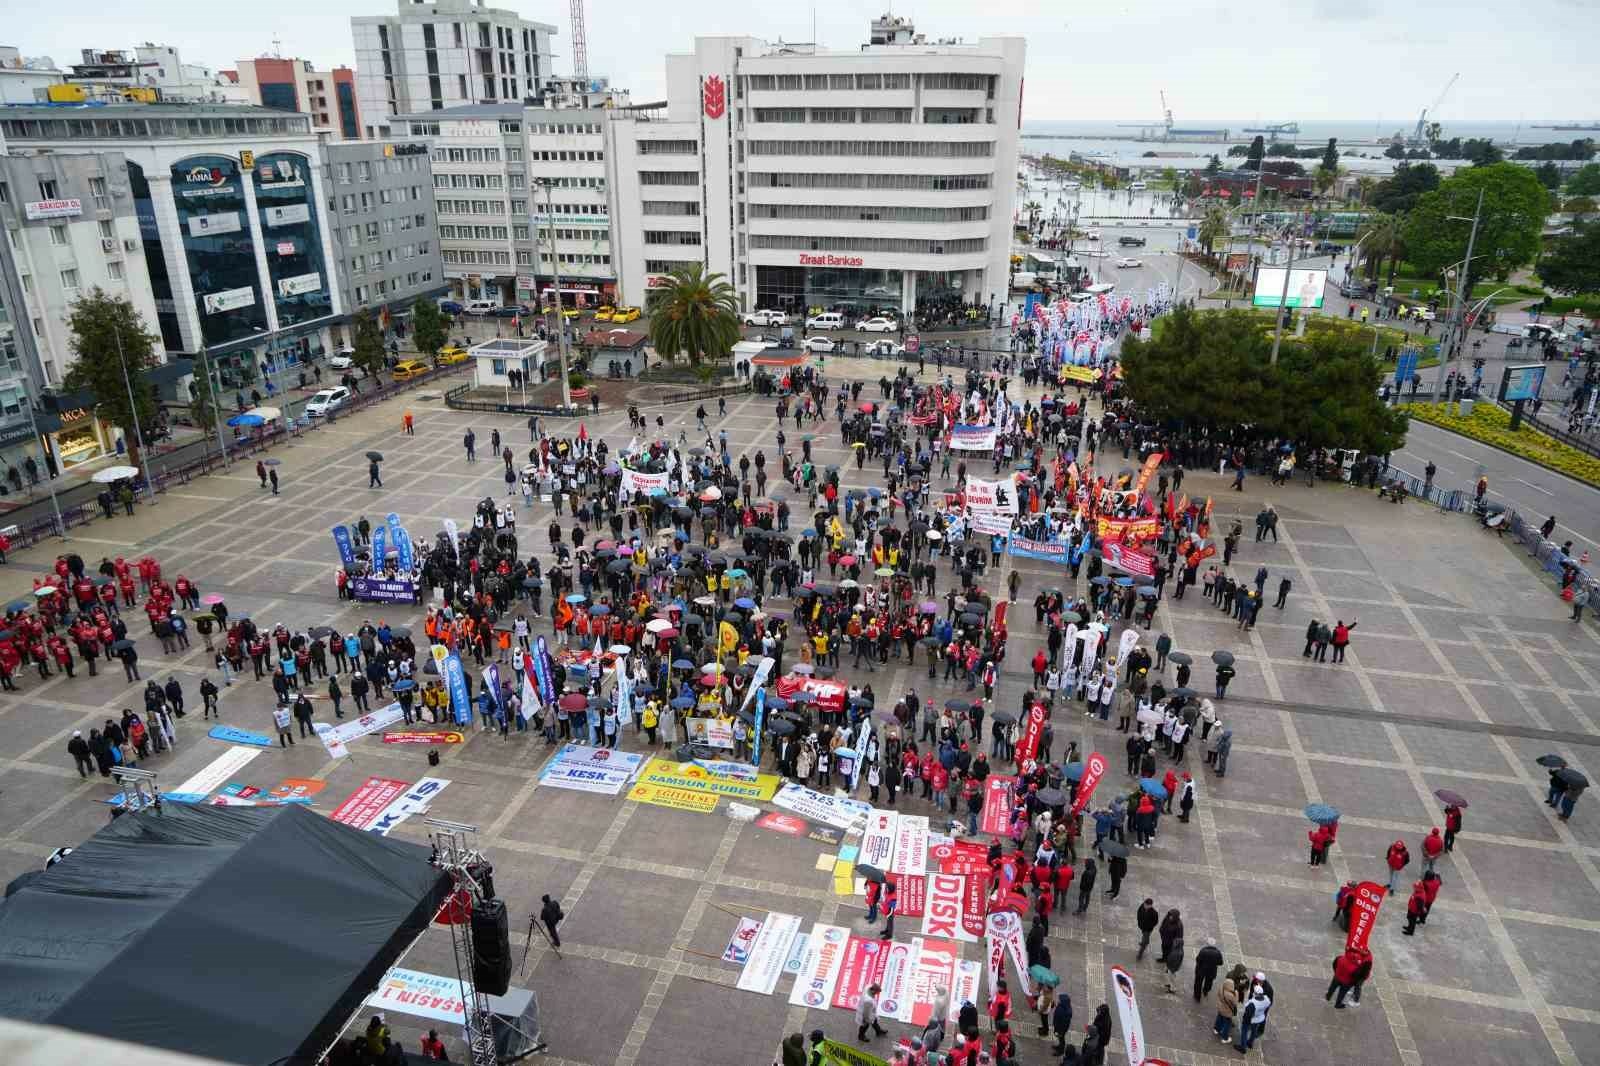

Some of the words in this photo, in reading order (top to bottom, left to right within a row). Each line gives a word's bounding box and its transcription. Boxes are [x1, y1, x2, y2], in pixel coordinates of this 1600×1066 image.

[185, 173, 213, 183] KANAL
[800, 254, 826, 265] Ziraat
[827, 254, 863, 266] Bankası
[566, 768, 608, 781] KESK
[648, 774, 707, 789] SAMSUN
[710, 783, 761, 797] ŞUBESİ
[791, 804, 830, 821] SAMSUN
[396, 990, 466, 1014] AŞASIN
